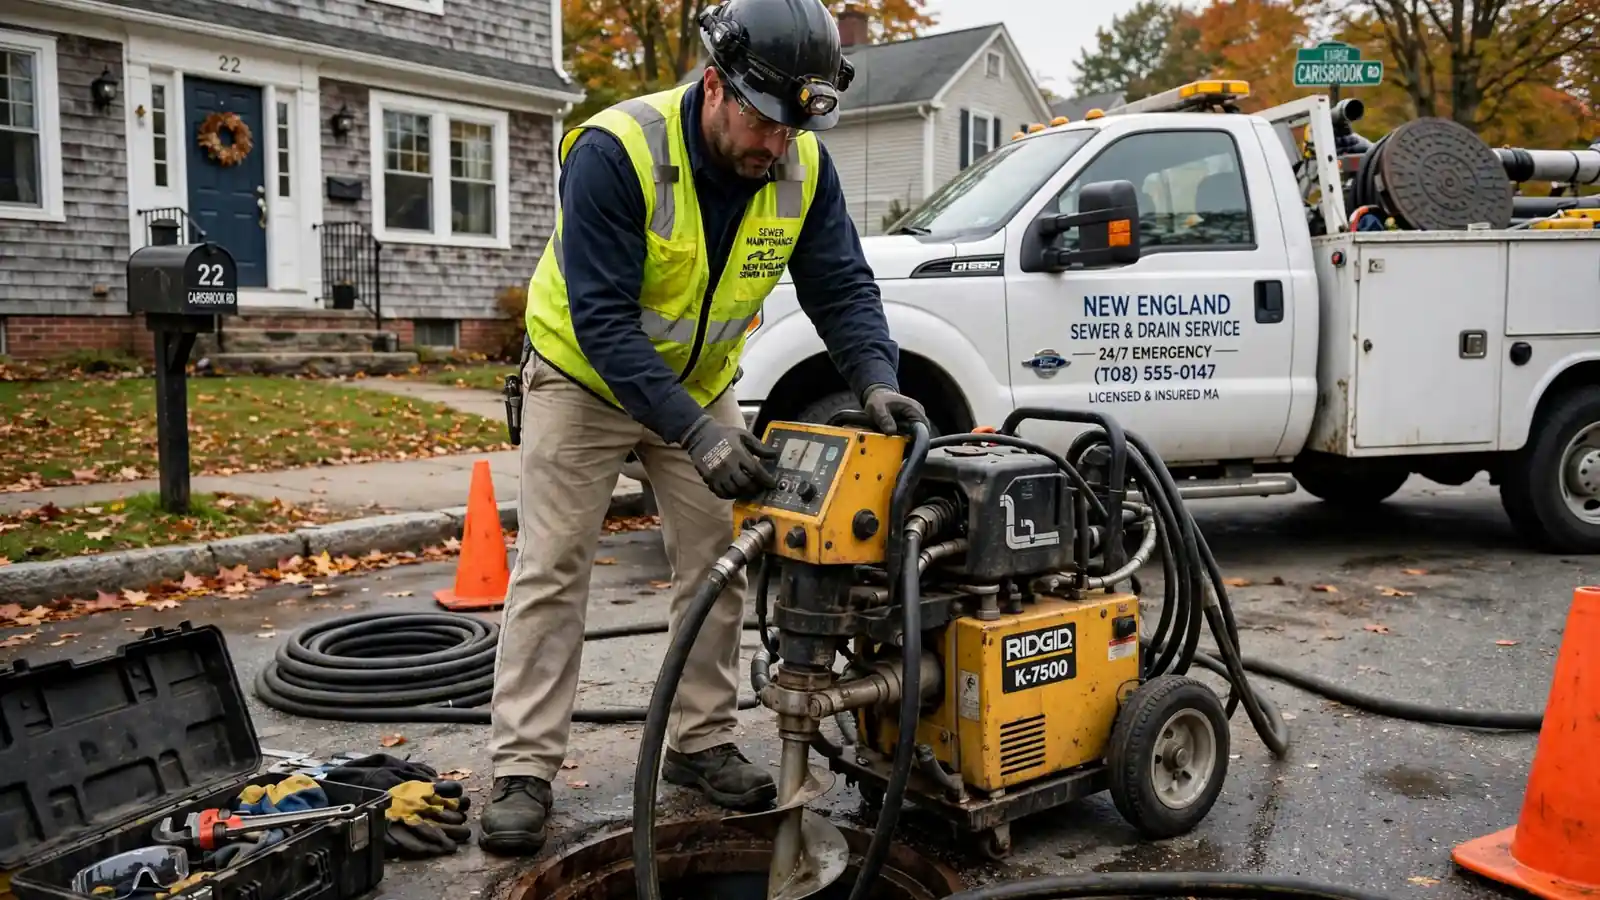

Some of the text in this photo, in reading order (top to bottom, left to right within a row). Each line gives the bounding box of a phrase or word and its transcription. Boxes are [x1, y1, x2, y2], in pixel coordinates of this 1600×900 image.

[219, 55, 241, 73] 22
[1297, 64, 1380, 83] CARISBROOK RD
[758, 228, 784, 236] SEWER
[198, 264, 224, 286] 22
[1083, 294, 1231, 317] NEW ENGLAND
[1071, 320, 1241, 340] SEWER & DRAIN SERVICE
[1099, 345, 1212, 362] 24/7 EMERGENCY
[1143, 364, 1216, 381] 555-0147
[1088, 388, 1220, 403] LICENSED & INSURED MA
[1015, 659, 1068, 687] K-7500
